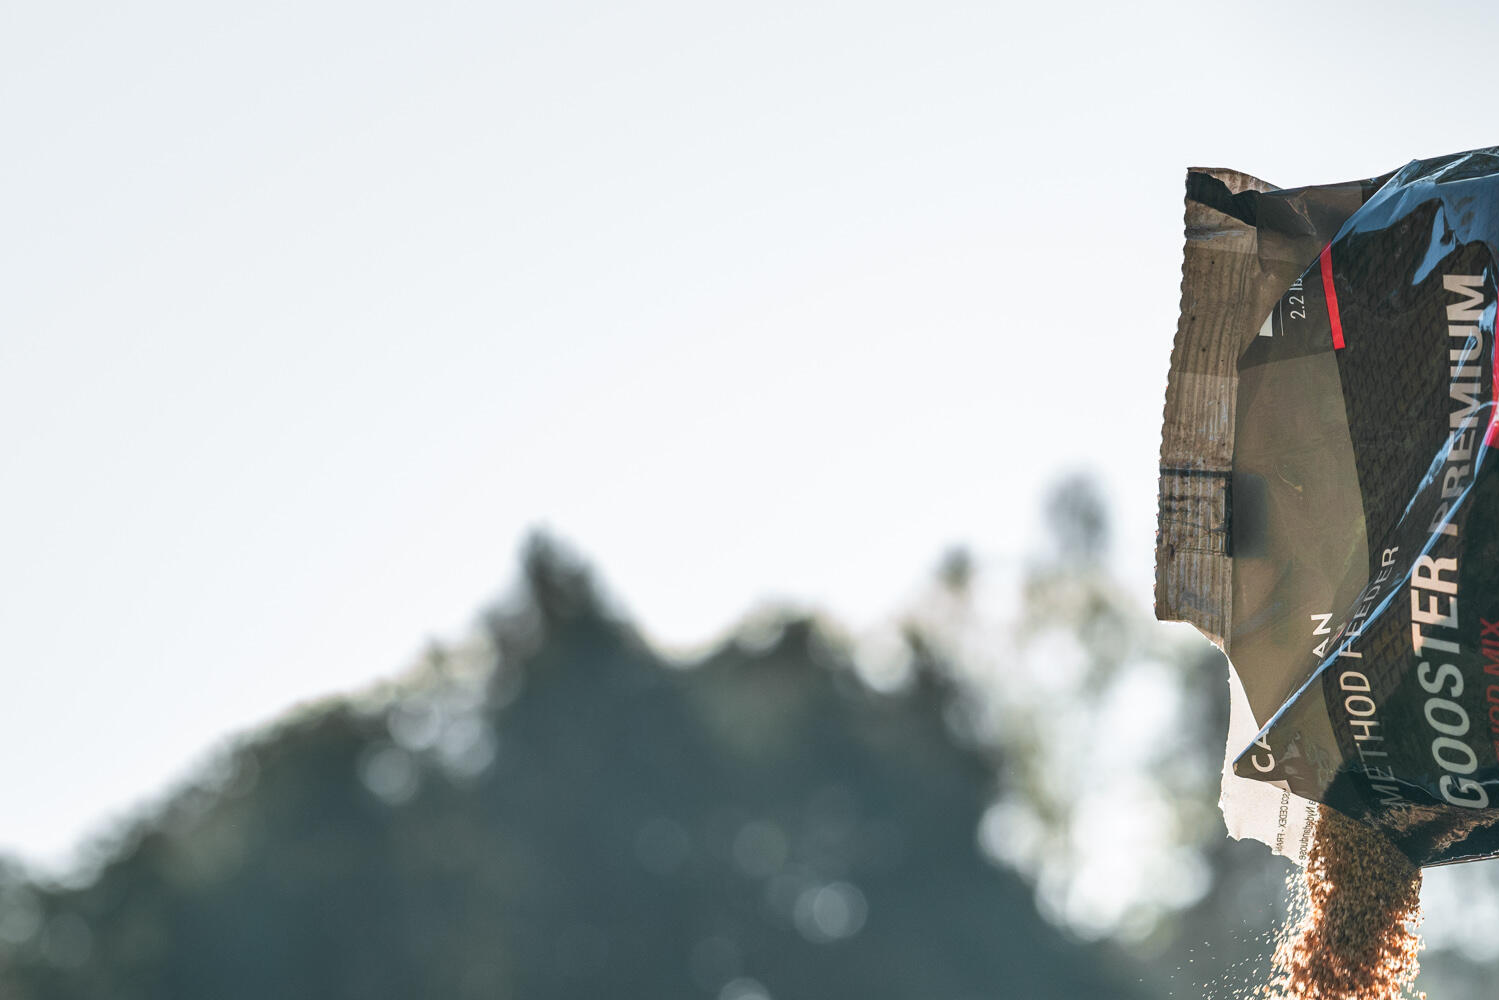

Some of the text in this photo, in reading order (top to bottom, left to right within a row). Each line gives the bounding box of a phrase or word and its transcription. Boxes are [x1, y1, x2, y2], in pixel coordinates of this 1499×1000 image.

[1288, 295, 1306, 320] 2.2
[1409, 273, 1490, 809] GOOSTER PREMIUM
[1338, 545, 1405, 807] METHOD FEEDER
